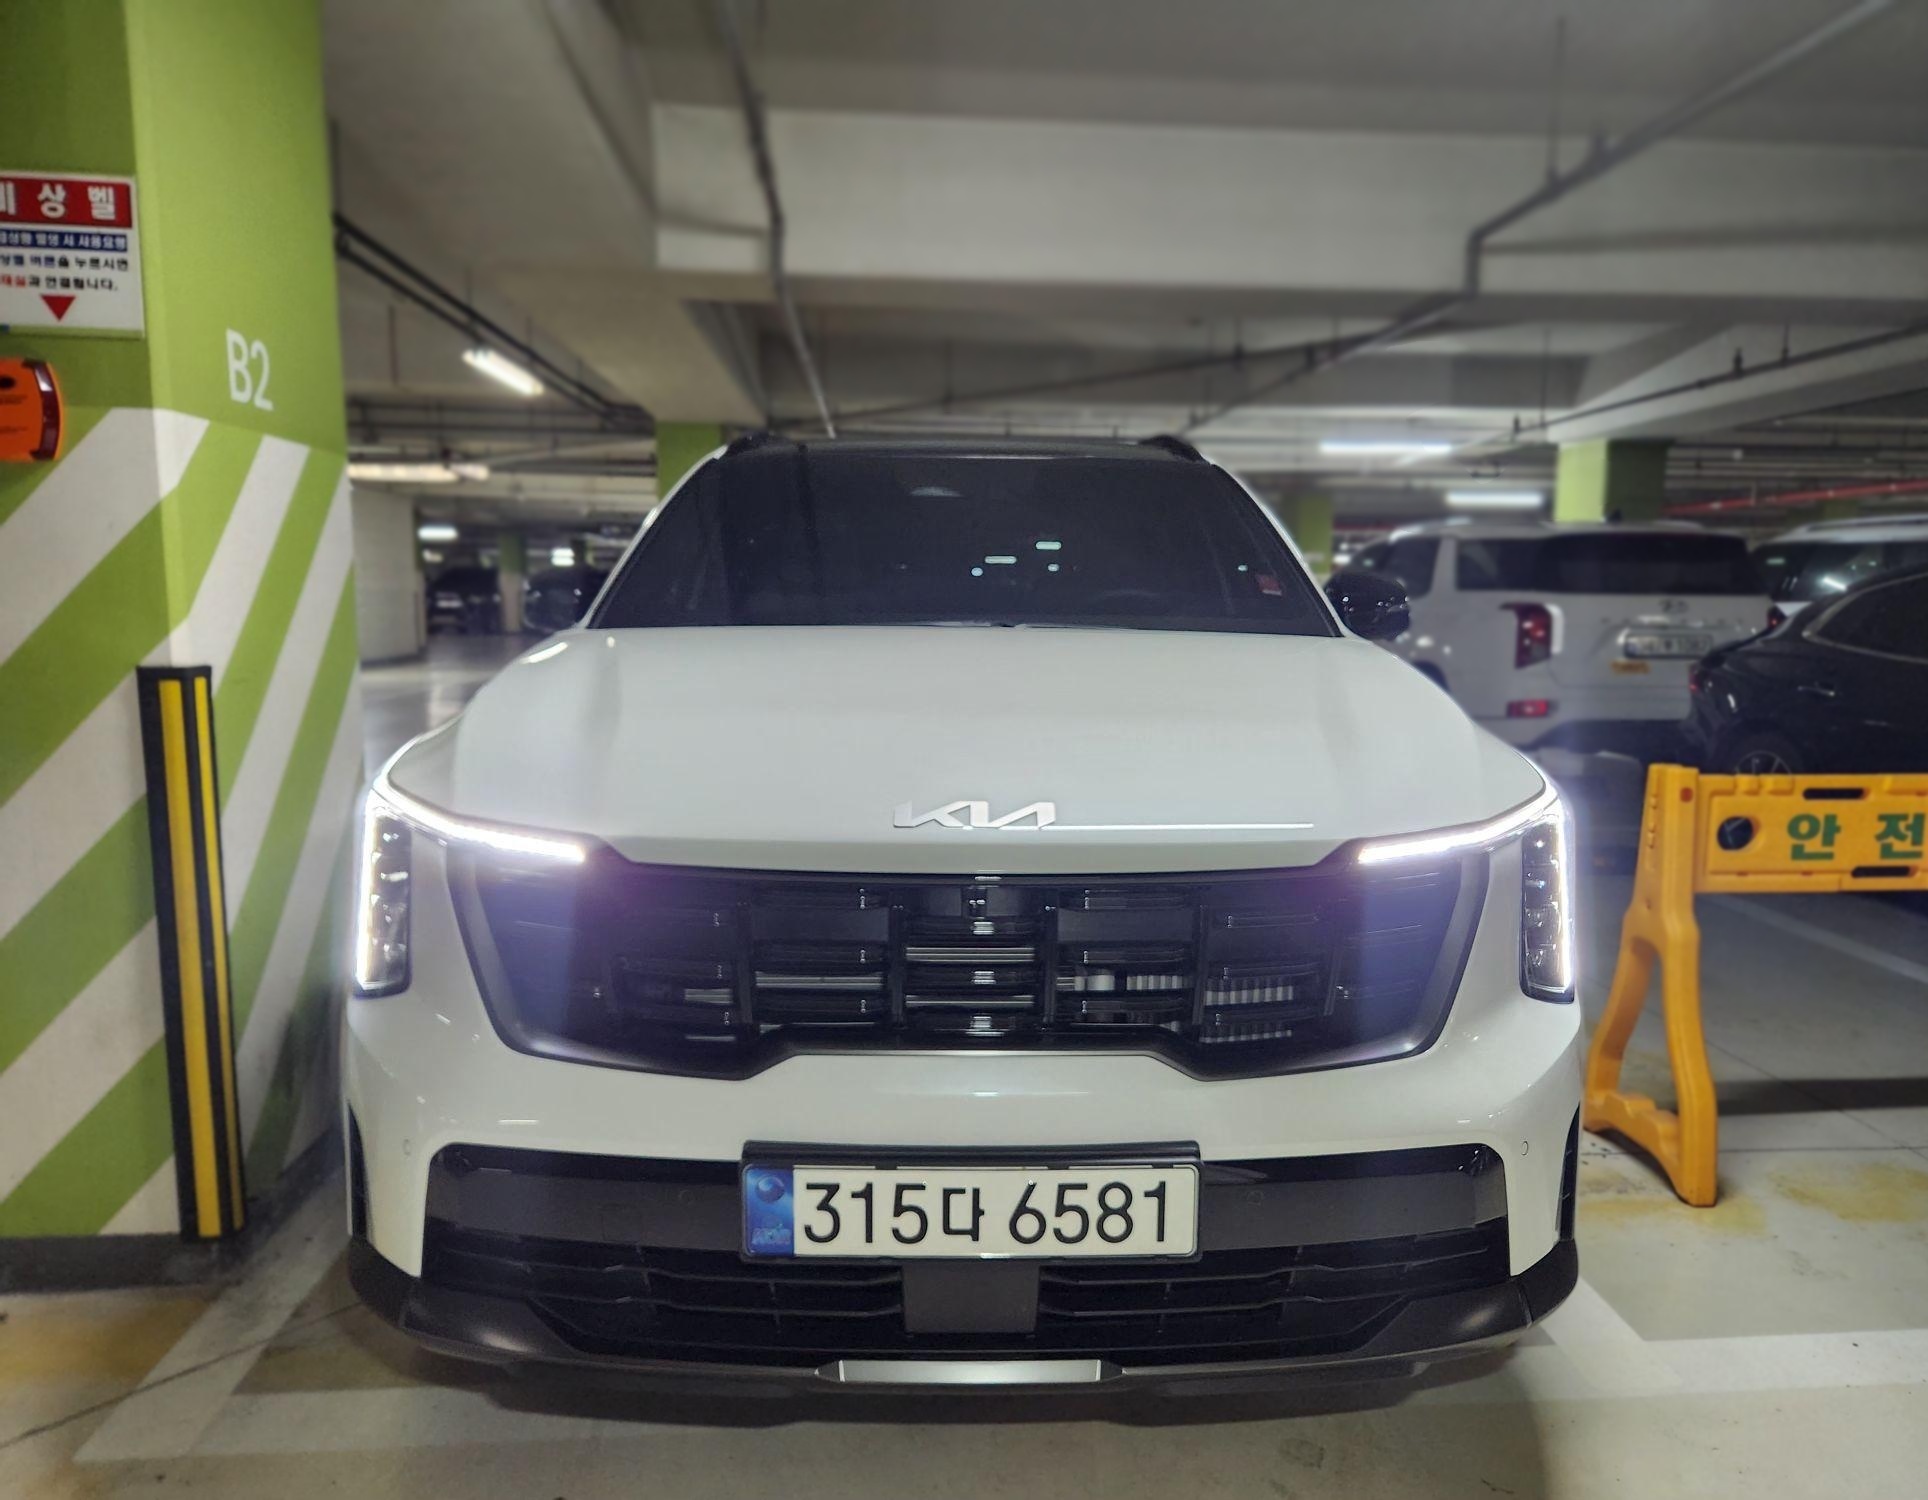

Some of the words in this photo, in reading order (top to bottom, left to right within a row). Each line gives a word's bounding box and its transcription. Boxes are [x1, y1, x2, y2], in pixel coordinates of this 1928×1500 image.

[75, 256, 128, 271] 누르시면
[226, 327, 274, 411] B2
[804, 1181, 985, 1245] 315다
[1008, 1180, 1166, 1245] 6581
